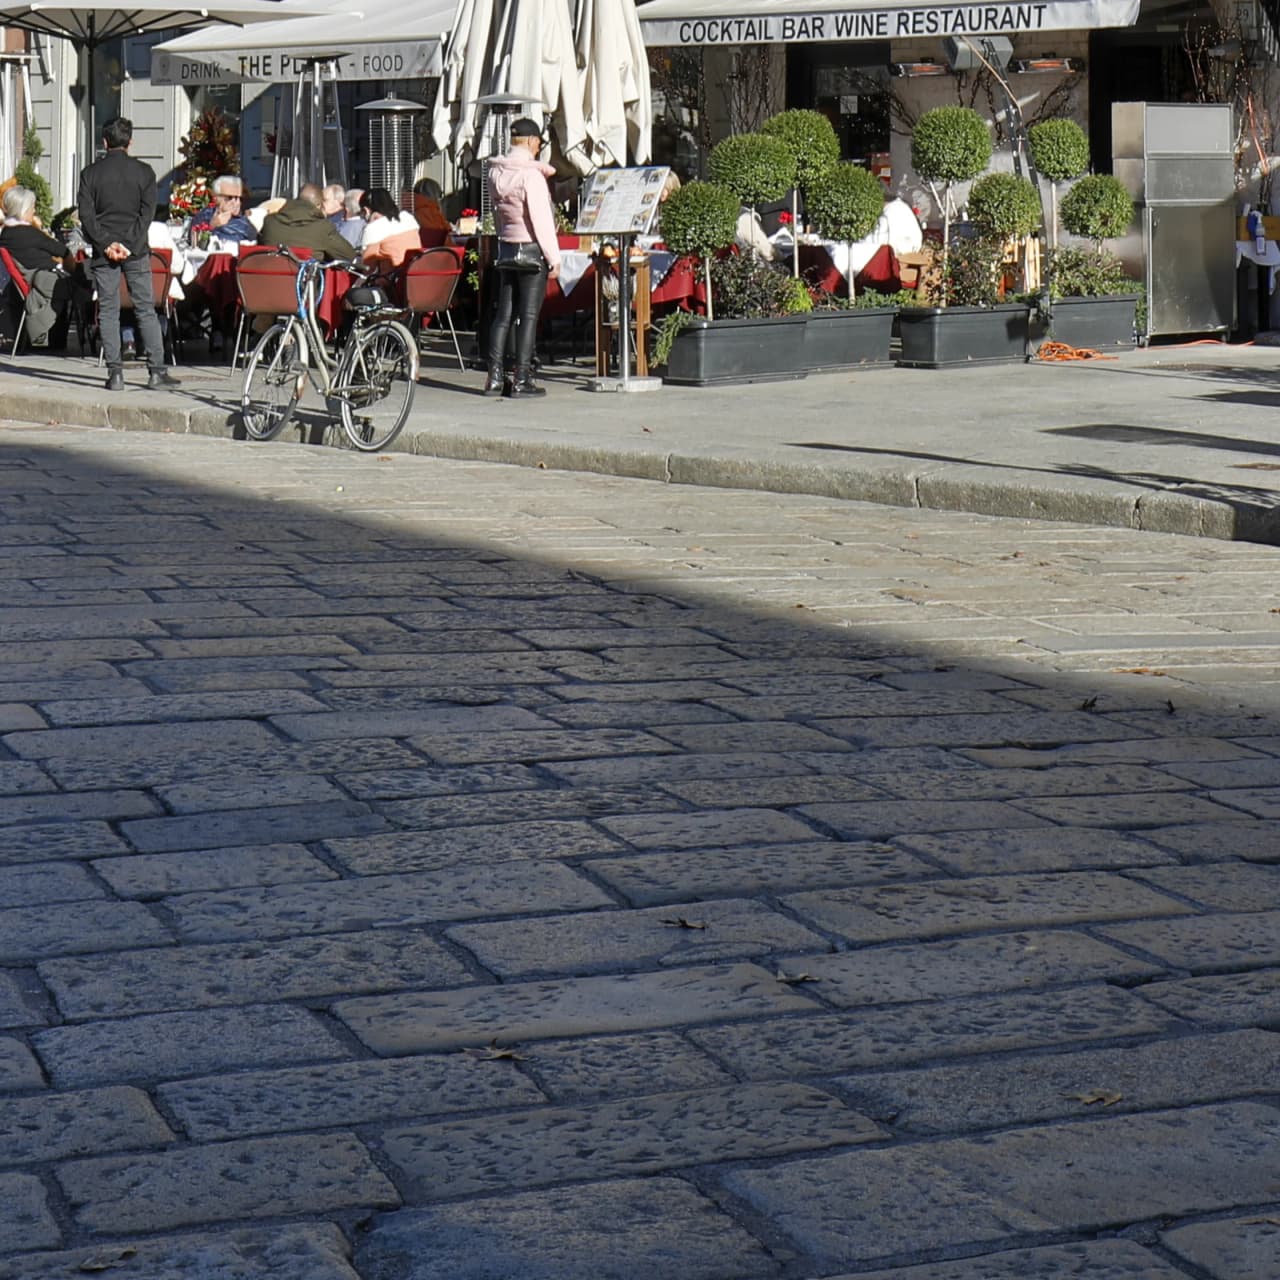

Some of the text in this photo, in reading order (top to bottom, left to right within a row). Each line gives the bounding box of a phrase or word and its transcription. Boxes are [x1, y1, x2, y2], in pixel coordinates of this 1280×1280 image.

[680, 5, 1048, 43] COCKTAIL BAR WINE RESTAURANT
[181, 62, 221, 80] DRINK
[238, 54, 273, 77] THE
[363, 55, 404, 73] FOOD
